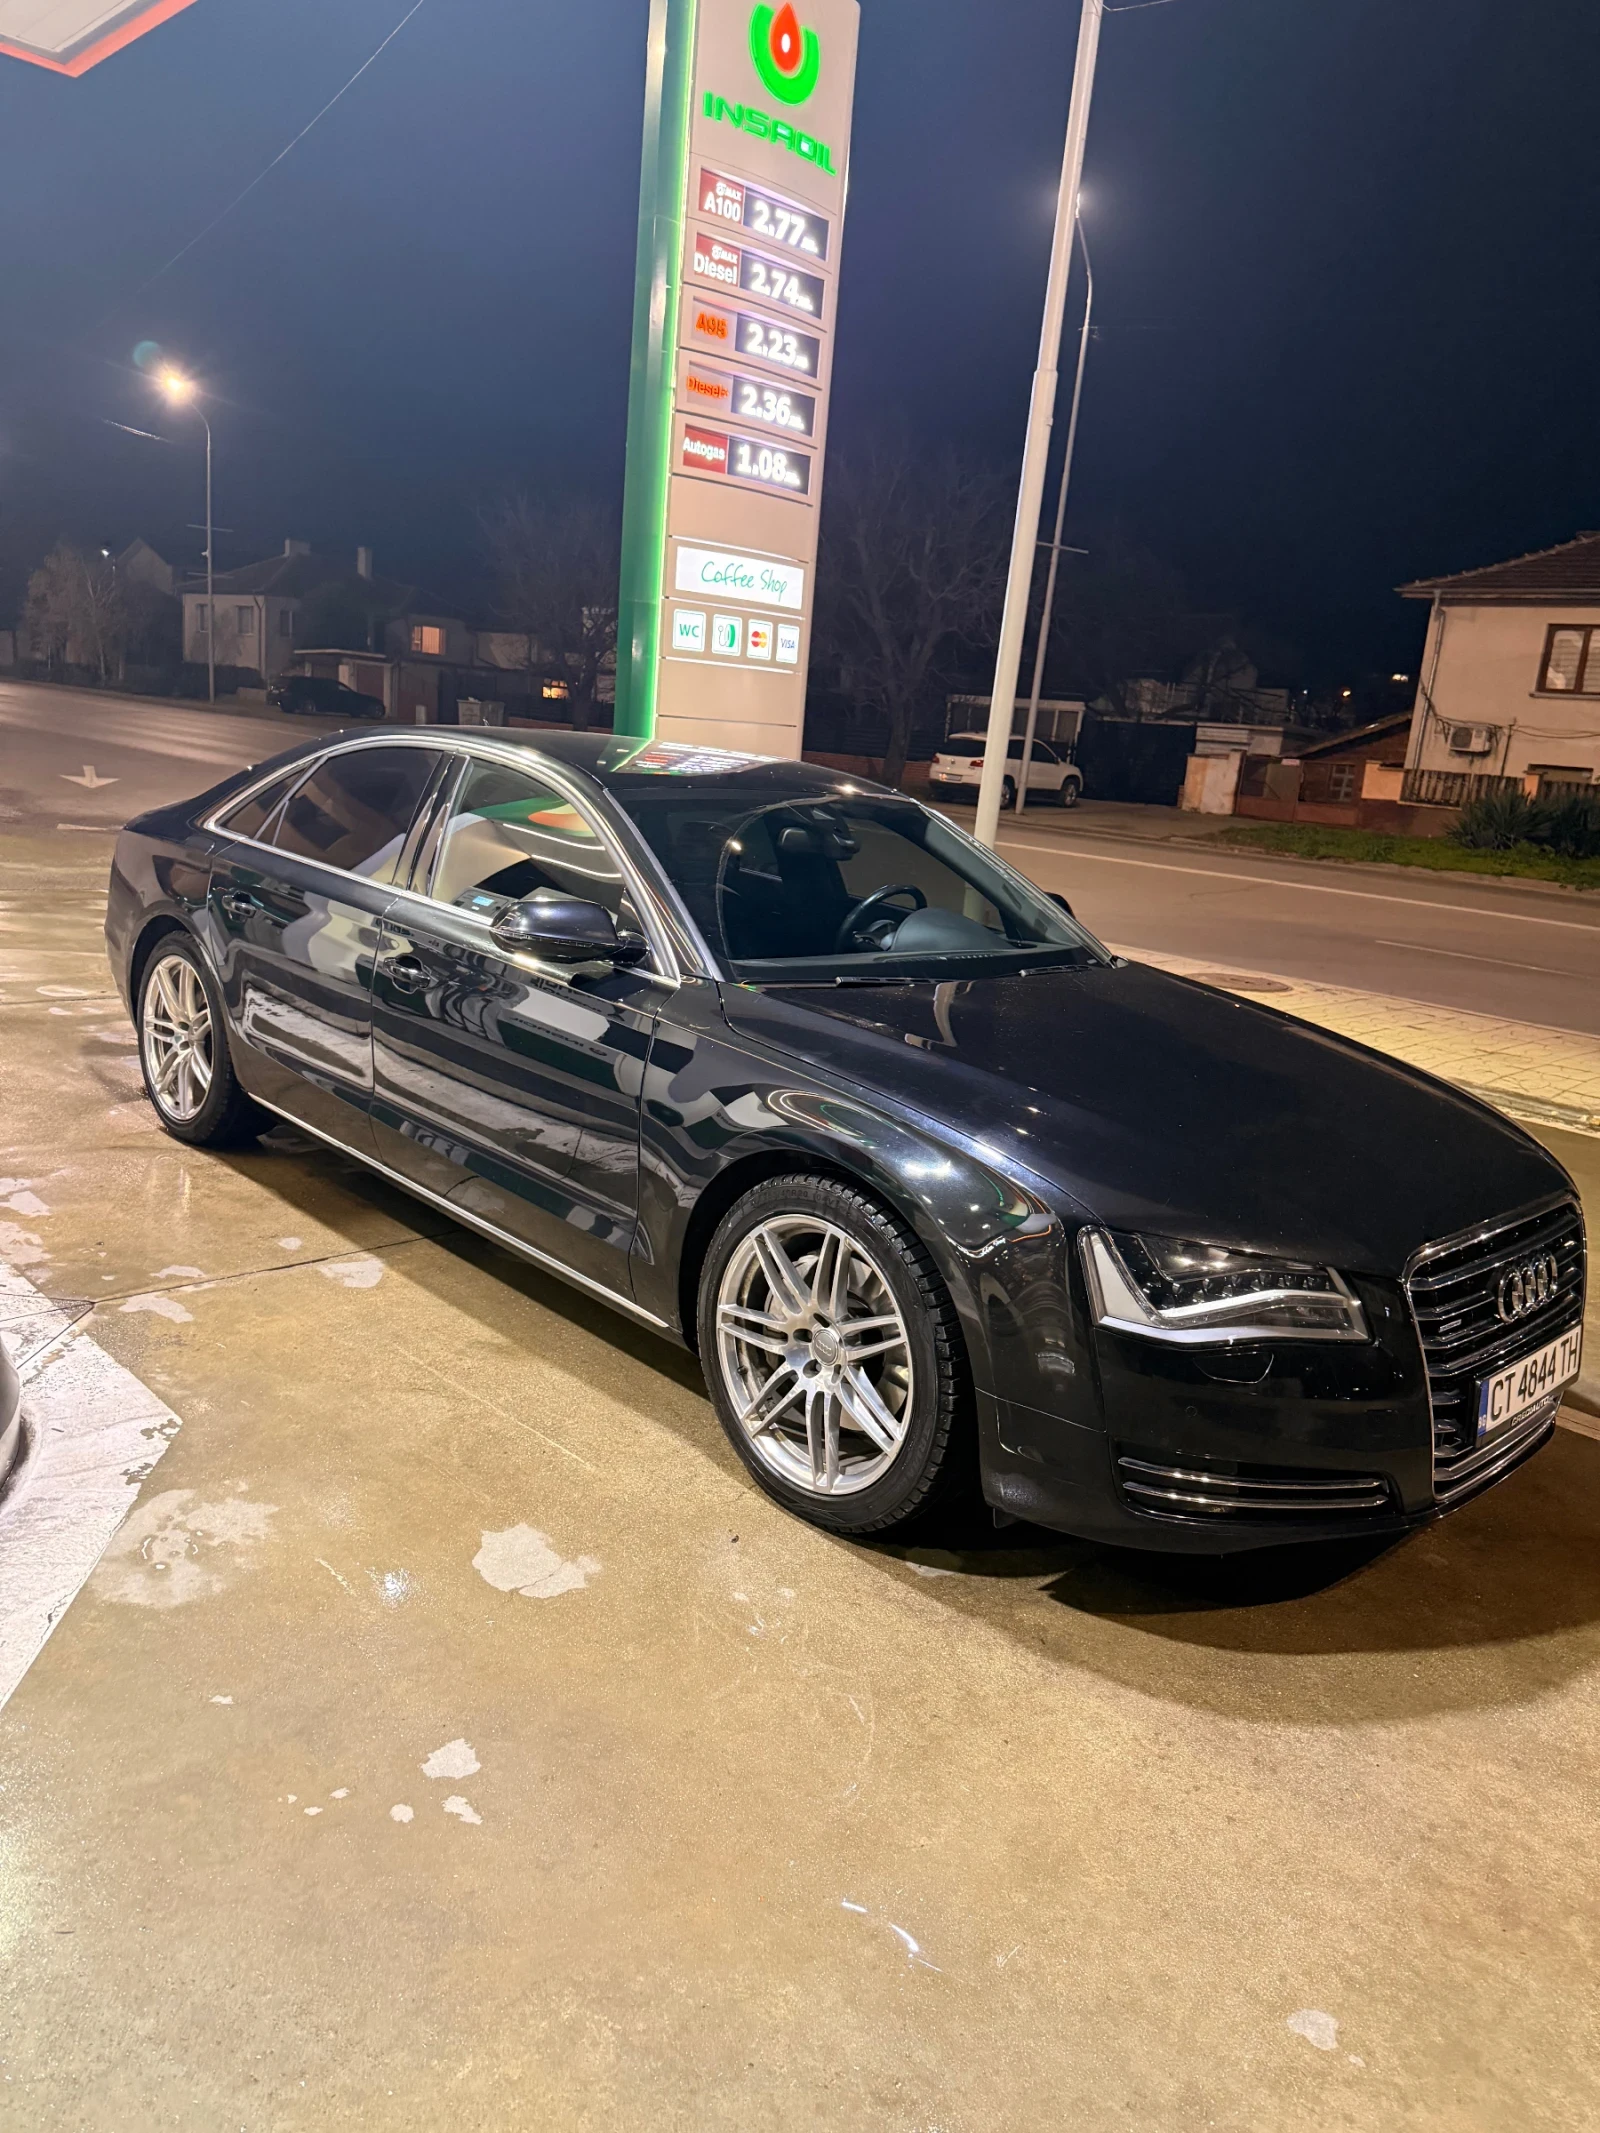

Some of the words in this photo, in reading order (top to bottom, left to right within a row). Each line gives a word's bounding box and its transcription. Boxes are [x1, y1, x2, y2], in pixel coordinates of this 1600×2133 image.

[703, 91, 837, 176] INSAOIL
[703, 191, 741, 222] A100
[752, 200, 806, 247] 2.77
[693, 252, 738, 285] Diesel
[750, 263, 800, 304] 2.74
[695, 312, 728, 339] A95
[746, 323, 797, 365] 2.23
[741, 385, 791, 426] 2.36
[682, 437, 726, 460] Autogas
[737, 444, 787, 481] 1.08
[701, 561, 755, 588] Coffee
[760, 569, 787, 602] Shop
[679, 624, 700, 638] WC
[780, 638, 796, 649] VISA
[1491, 1371, 1516, 1422] CT
[1518, 1346, 1557, 1404] 4844
[1561, 1332, 1579, 1377] TH
